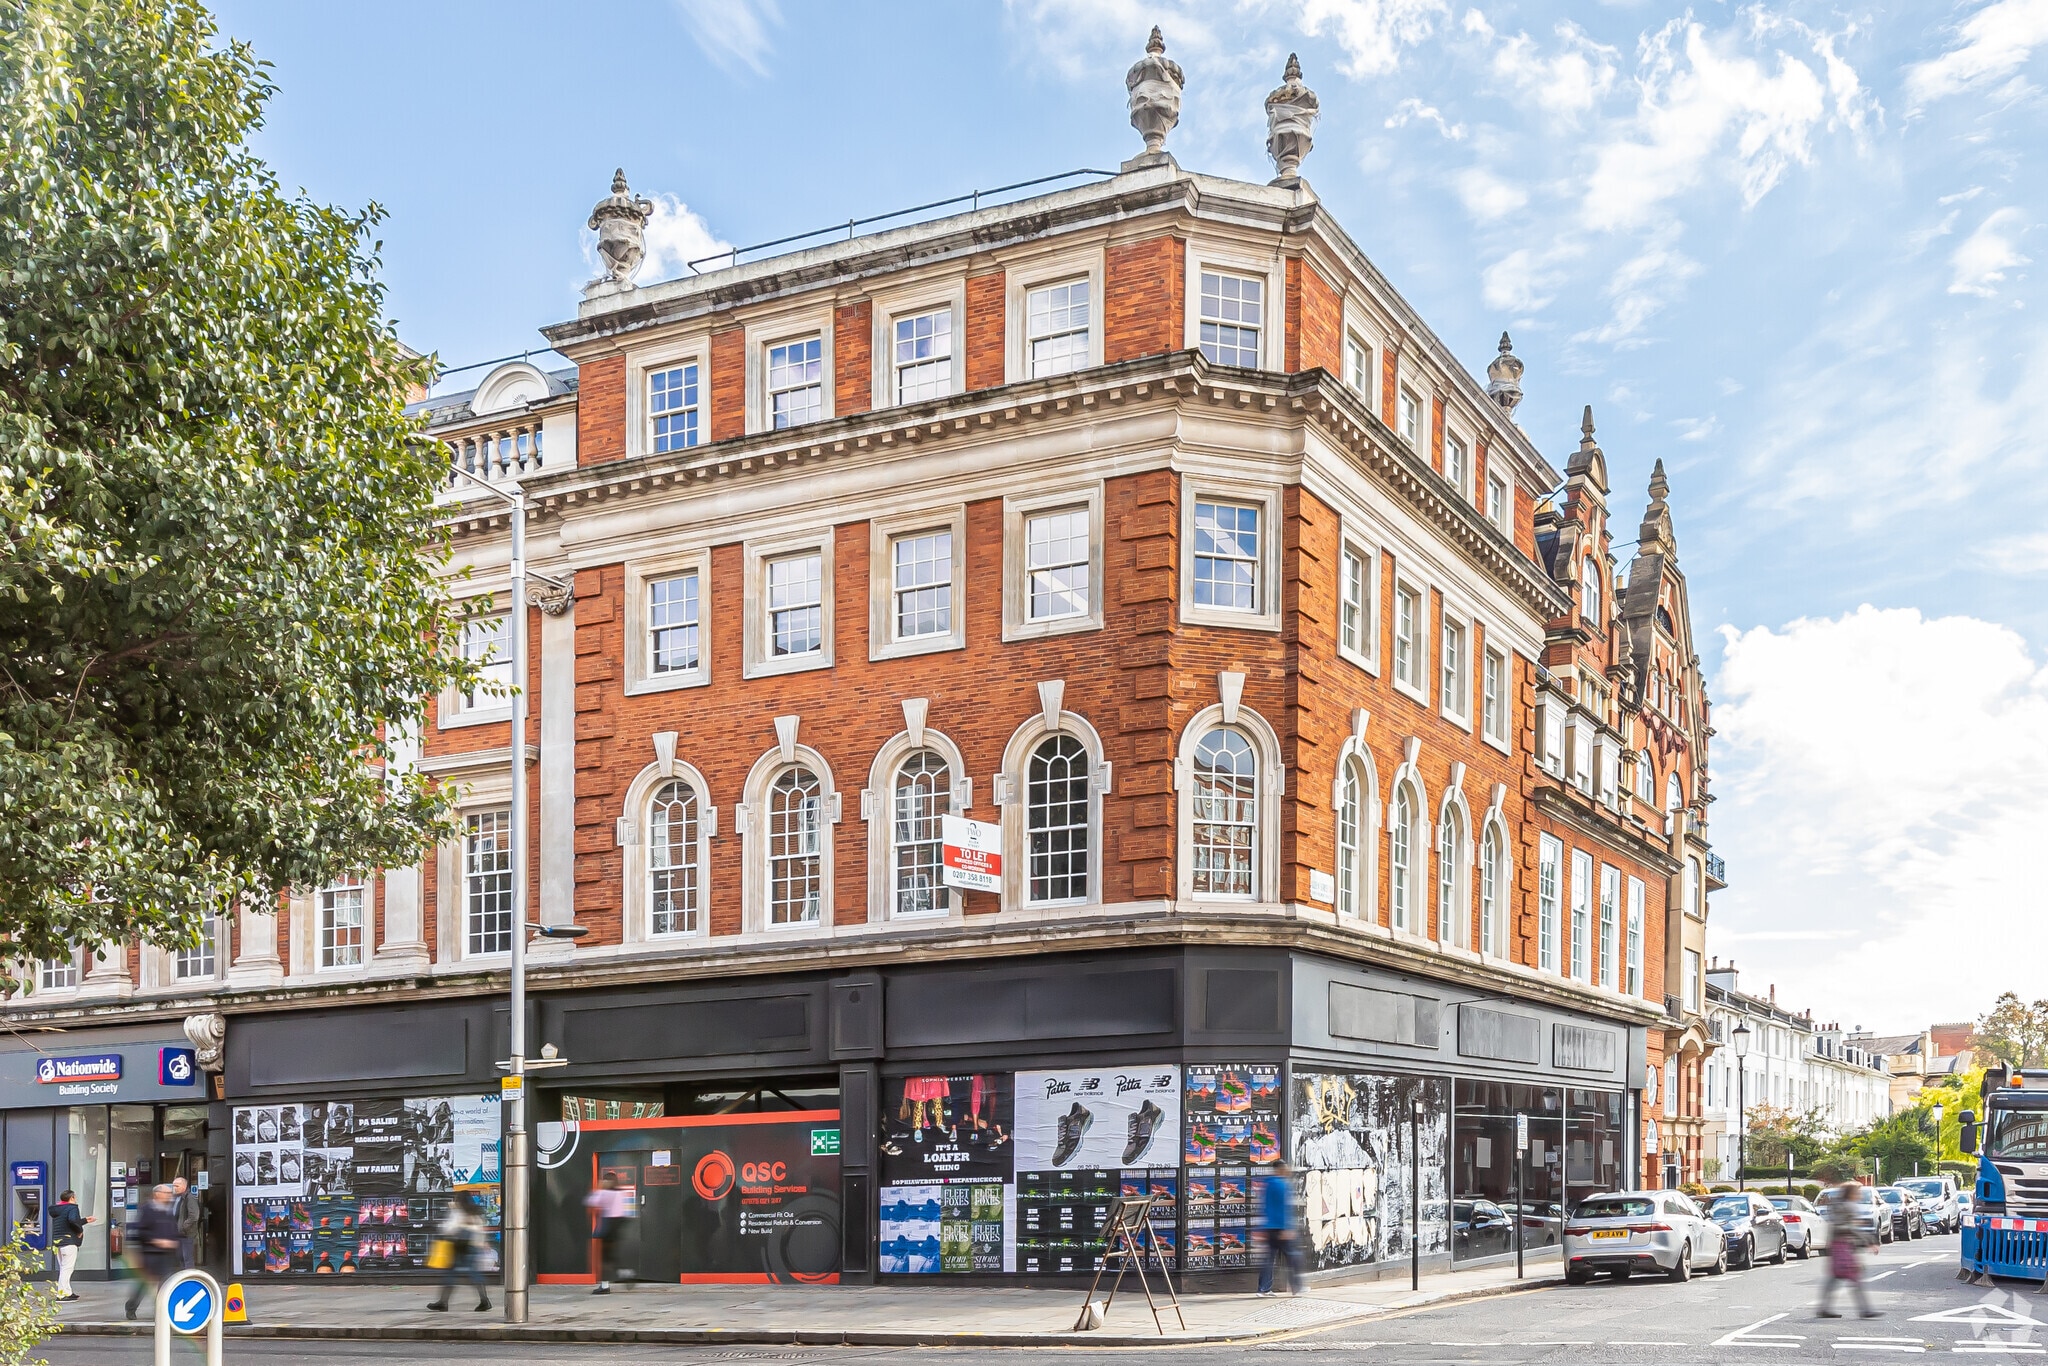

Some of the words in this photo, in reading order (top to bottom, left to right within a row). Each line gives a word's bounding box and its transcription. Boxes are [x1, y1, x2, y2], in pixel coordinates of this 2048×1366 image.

[960, 848, 971, 859] TO
[973, 851, 987, 862] LET
[953, 870, 966, 879] 0207
[968, 872, 978, 881] 358
[56, 1059, 116, 1076] Nationwide
[59, 1084, 89, 1096] Building
[91, 1083, 118, 1095] Society
[1045, 1078, 1071, 1100] Patta
[1114, 1075, 1142, 1097] Patta
[370, 1117, 398, 1125] SALIEU
[924, 1153, 970, 1162] LOAFER
[742, 1161, 787, 1183] QSC
[741, 1186, 772, 1195] Building
[774, 1185, 806, 1193] Services
[944, 1188, 969, 1197] FLEET
[975, 1188, 1000, 1197] FLEET
[944, 1197, 969, 1206] FOXES
[975, 1197, 1000, 1206] FOXES
[944, 1225, 969, 1234] FLEET
[975, 1224, 1000, 1233] FLEET
[944, 1233, 969, 1242] FOXES
[975, 1233, 1000, 1242] FOXES
